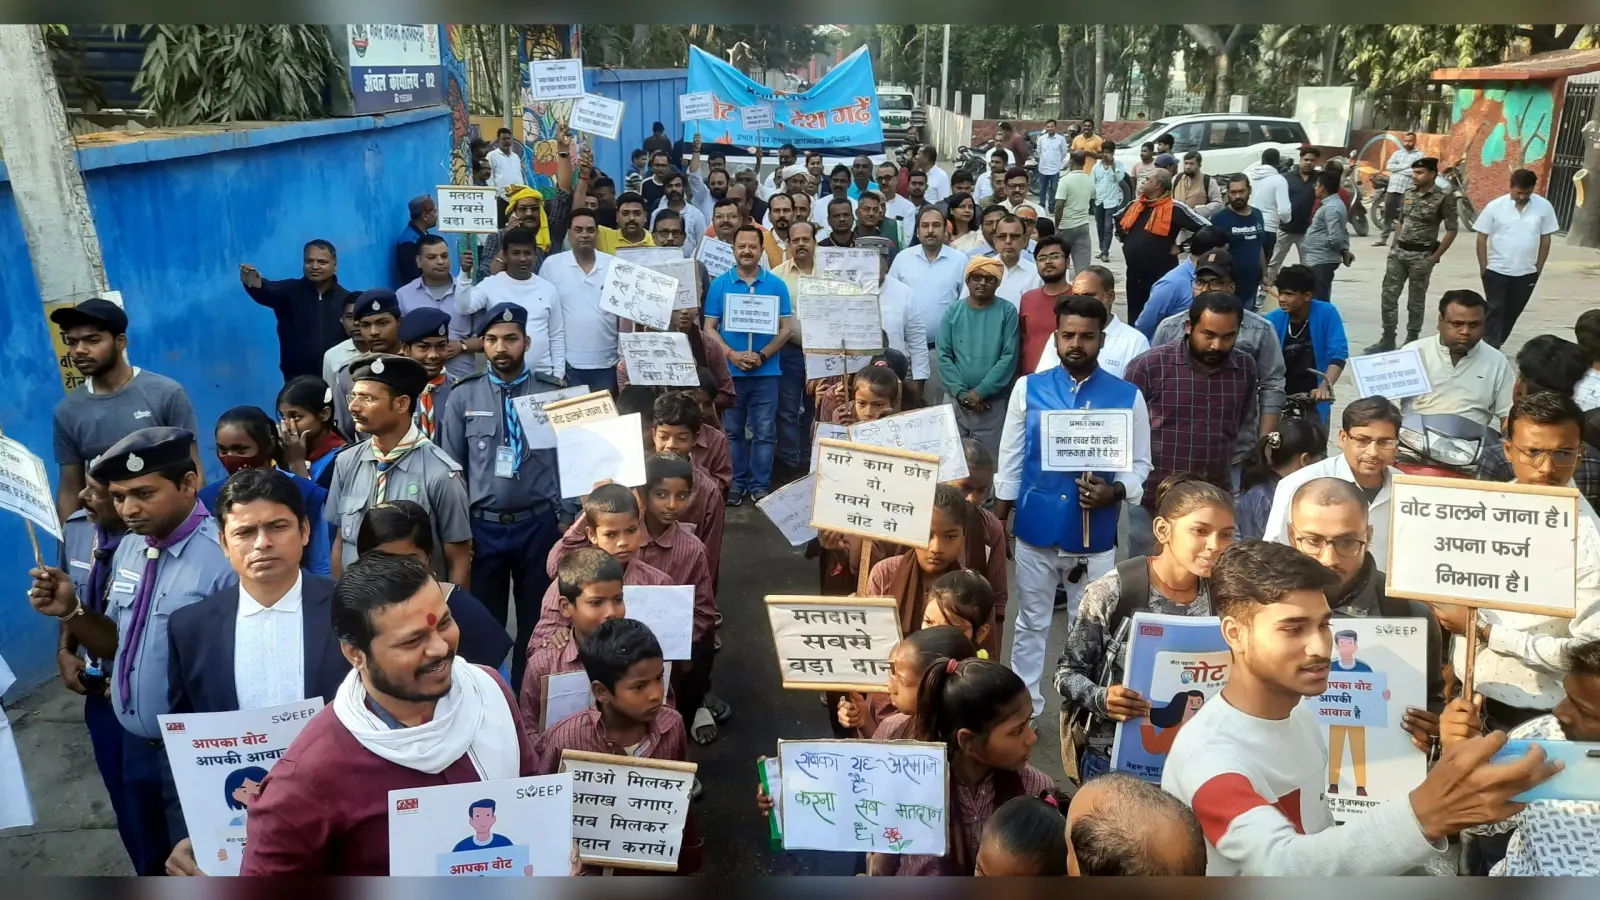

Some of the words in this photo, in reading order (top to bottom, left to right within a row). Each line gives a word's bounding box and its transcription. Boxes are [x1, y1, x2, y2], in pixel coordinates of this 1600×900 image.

[388, 68, 419, 90] कार्यालय
[790, 108, 826, 129] देश
[449, 191, 484, 200] मतदान
[451, 202, 484, 213] सबसे
[443, 217, 464, 227] बड़ा
[473, 217, 494, 226] दान
[583, 406, 603, 416] जाना
[1090, 434, 1101, 444] देता
[1102, 433, 1119, 445] संदेश
[1087, 447, 1096, 457] की
[1096, 447, 1102, 457] है
[827, 452, 853, 467] सारे
[863, 458, 894, 473] काम
[904, 462, 932, 481] छोड़
[867, 476, 886, 493] दो,
[835, 492, 870, 509] सबसे
[881, 500, 915, 516] पहले
[1401, 497, 1430, 517] वोट
[1435, 501, 1487, 522] डालने
[1492, 507, 1539, 525] जाना
[1544, 505, 1568, 528] है।
[847, 513, 873, 528] वोट
[883, 517, 898, 533] दो
[1434, 536, 1486, 554] अपना
[1492, 537, 1531, 558] फर्ज
[1435, 563, 1500, 589] निभाना
[1505, 570, 1529, 593] है।
[791, 609, 868, 625] मतदान
[801, 629, 872, 650] सबसे
[787, 658, 833, 676] बड़ा
[850, 659, 896, 675] दान
[1181, 661, 1227, 684] वोट
[1354, 680, 1373, 690] वोट
[1319, 692, 1352, 703] आपकी
[1319, 708, 1351, 717] आवाज
[1353, 705, 1361, 719] है
[192, 736, 238, 749] आपका
[241, 732, 268, 746] वोट
[196, 750, 242, 766] आपकी
[573, 769, 616, 785] आओ
[627, 770, 686, 792] मिलकर
[628, 797, 678, 815] जगाए,
[610, 813, 668, 834] मिलकर
[573, 837, 611, 851] दान
[622, 840, 674, 857] करायें।
[450, 861, 489, 875] आपका
[492, 857, 513, 870] वोट
